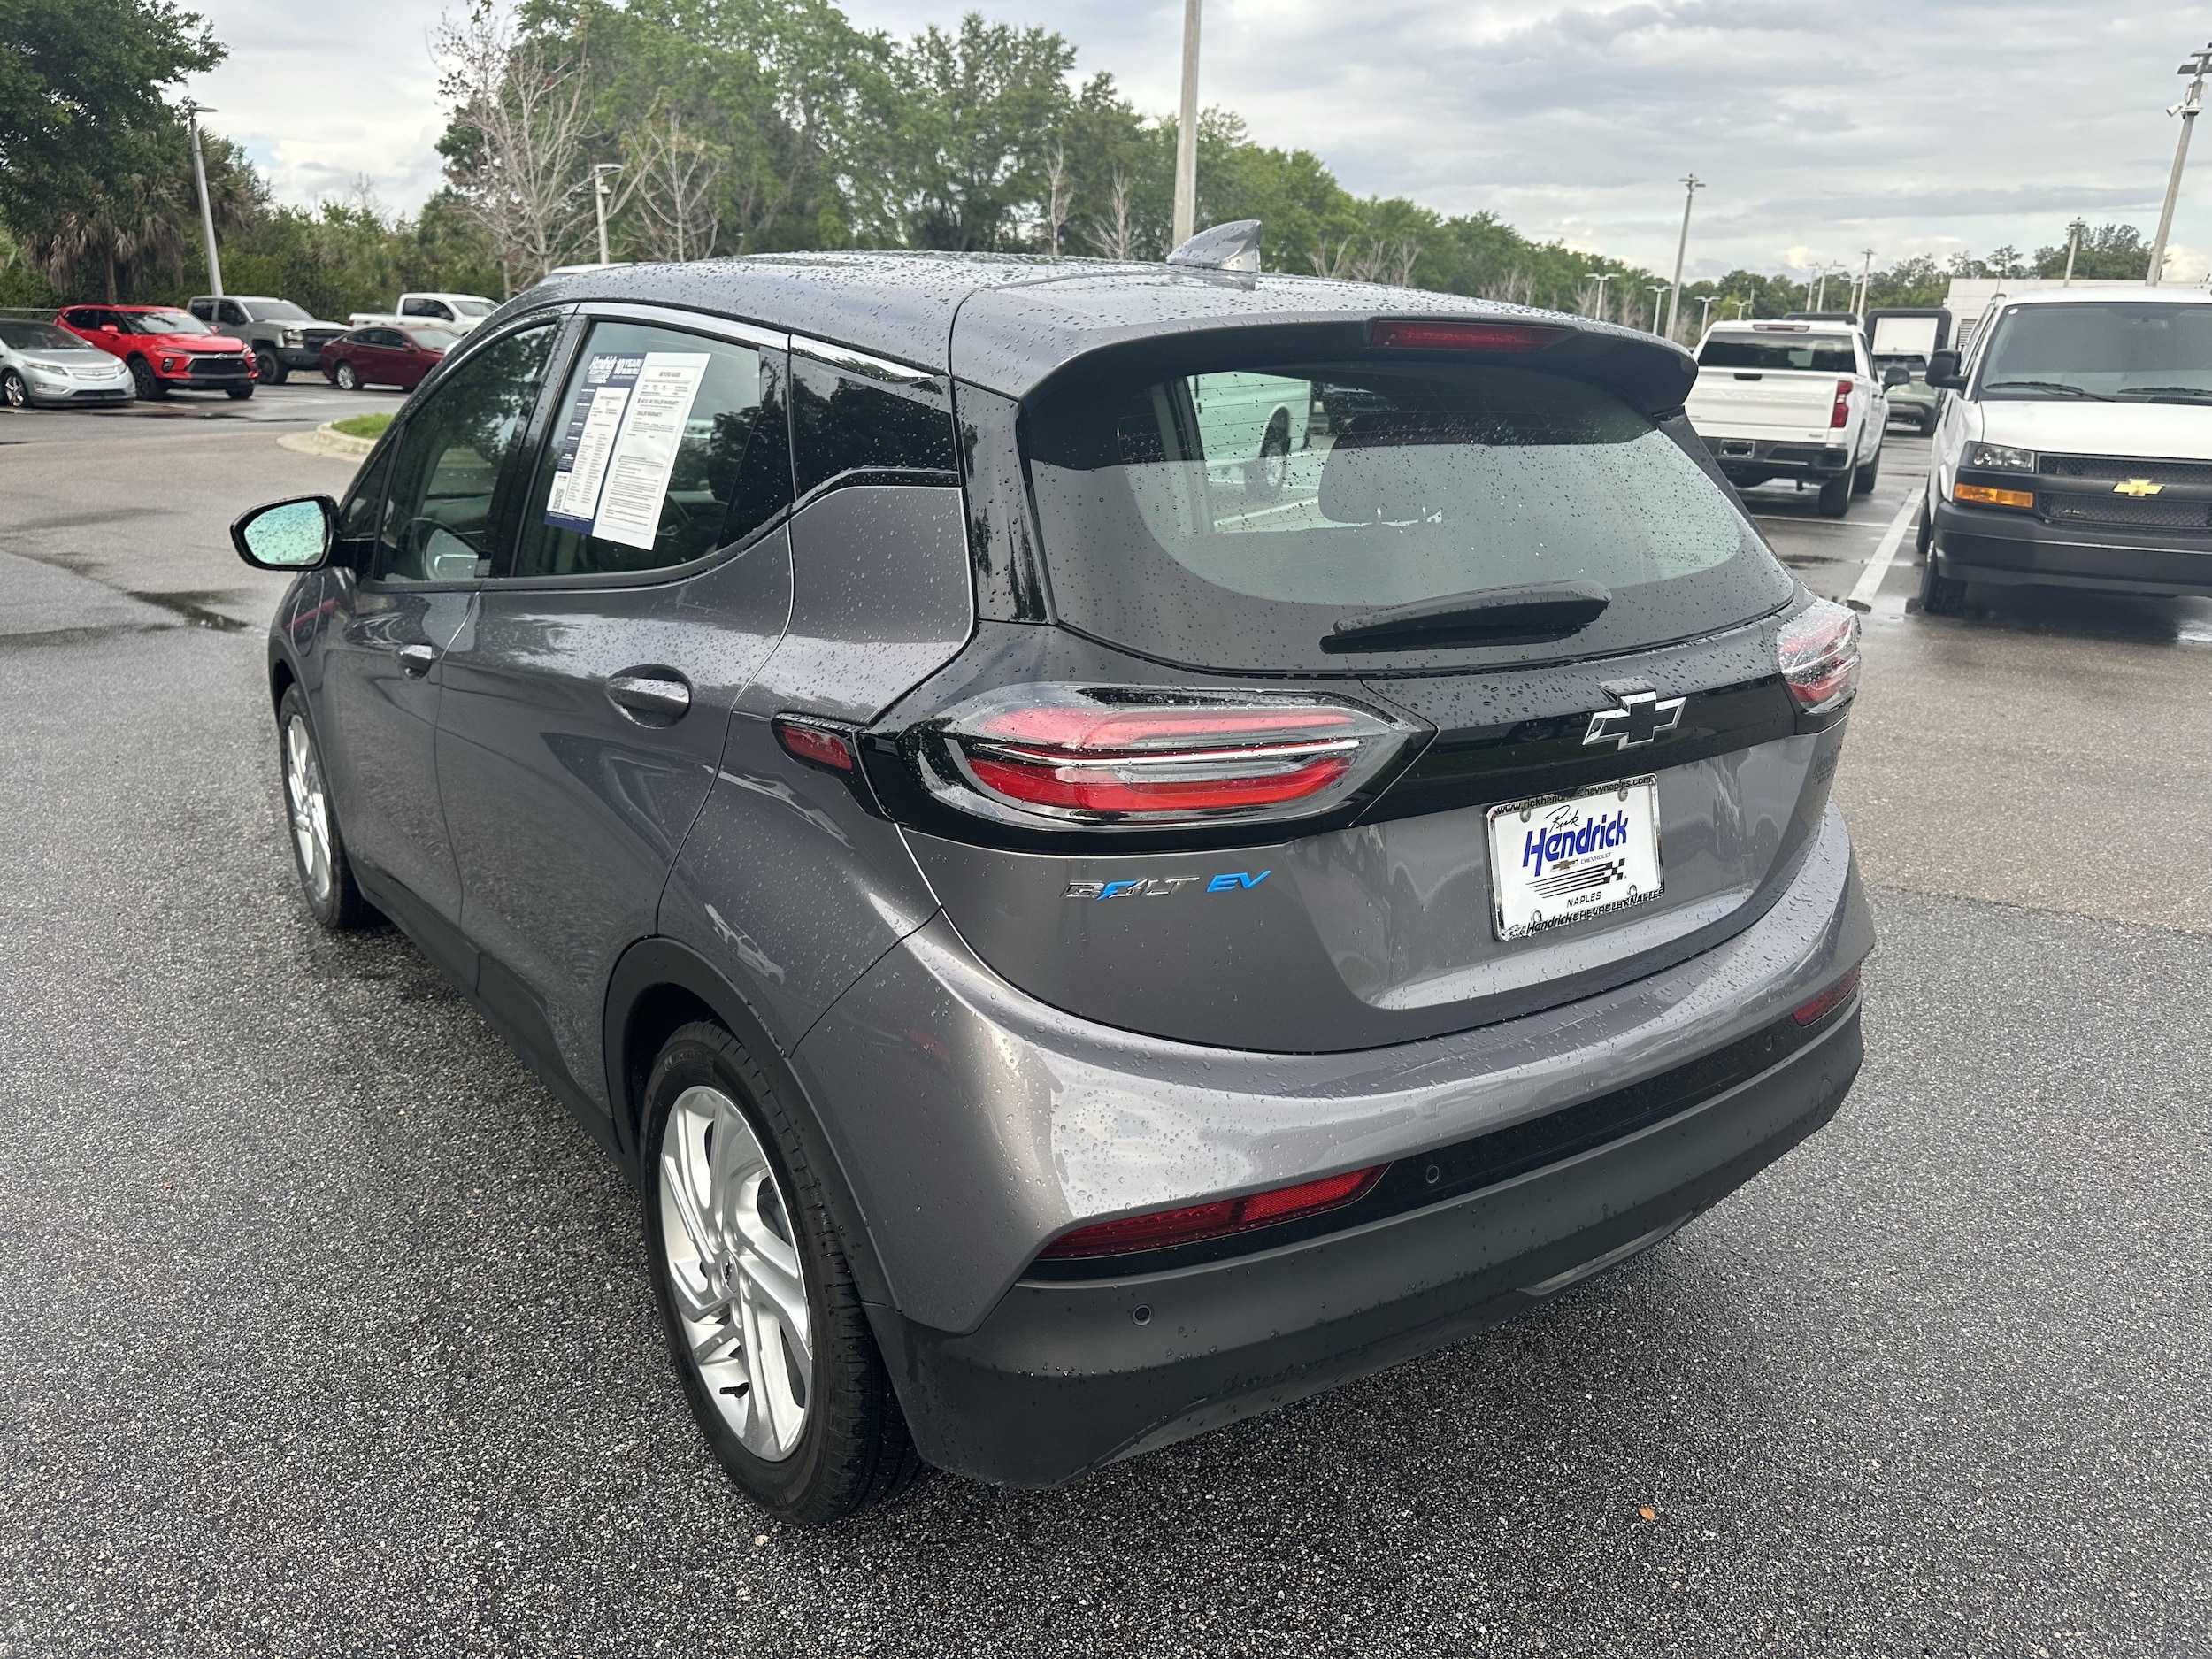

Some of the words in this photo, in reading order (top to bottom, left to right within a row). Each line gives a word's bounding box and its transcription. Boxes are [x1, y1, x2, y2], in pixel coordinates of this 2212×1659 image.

[1523, 810, 1629, 877] Hendrick
[1580, 852, 1612, 864] CHEVROLET
[1060, 876, 1200, 901] BOLT
[1206, 870, 1271, 893] EV
[1567, 891, 1601, 909] NAPLES
